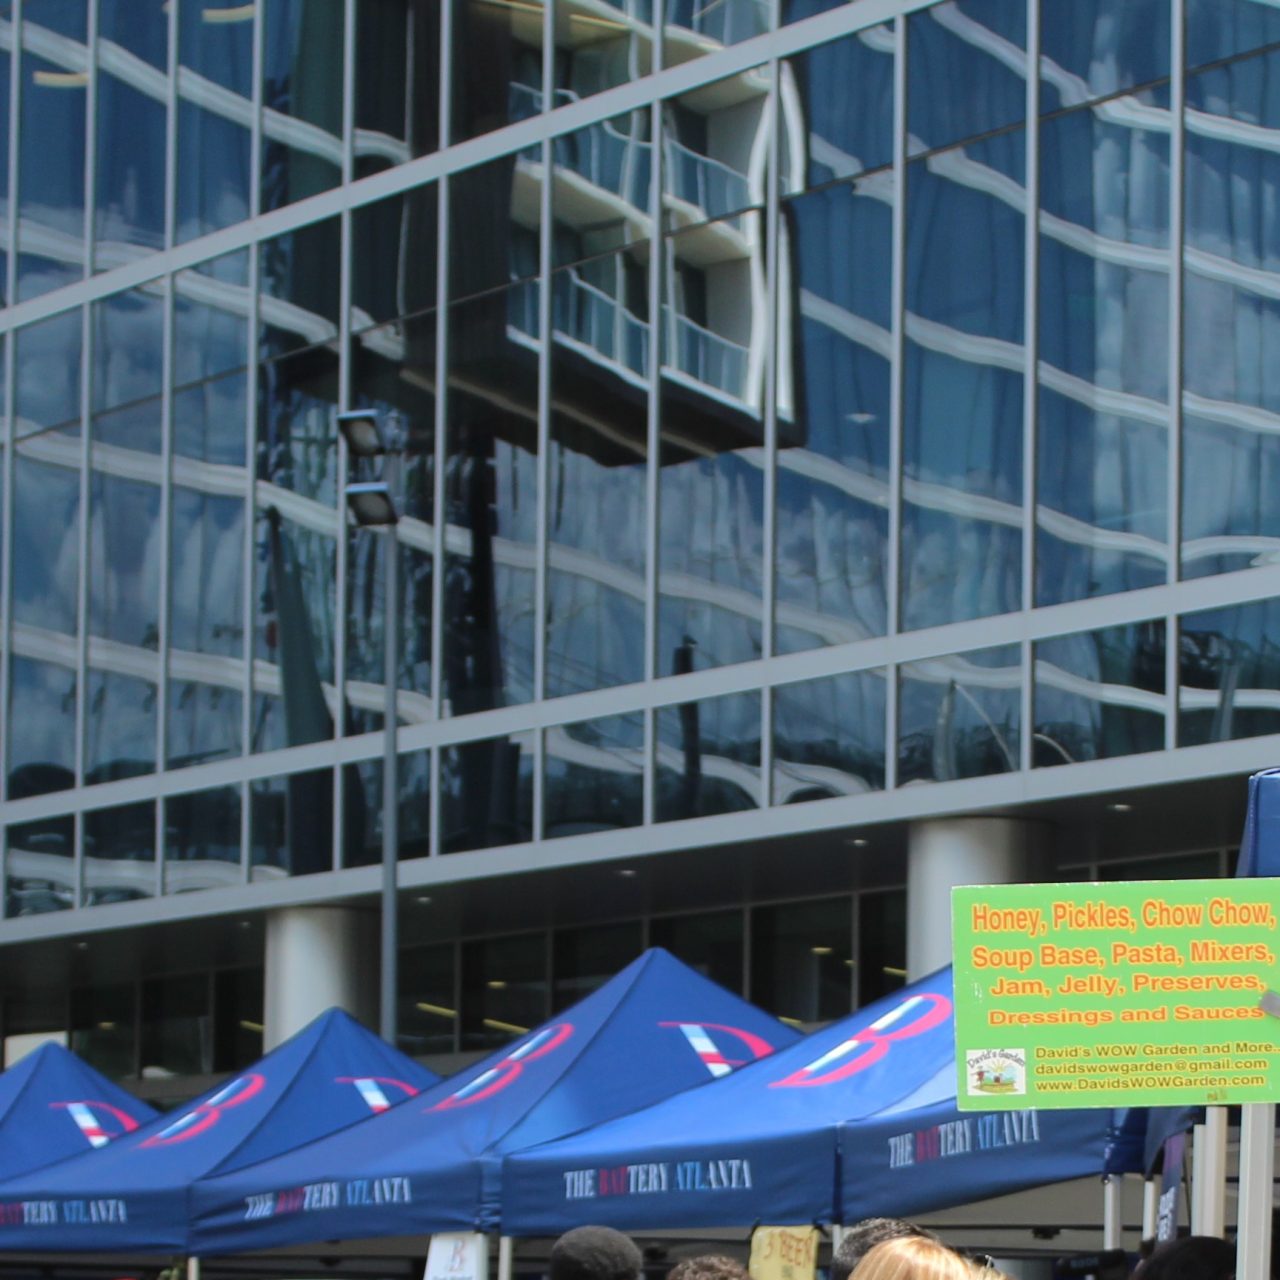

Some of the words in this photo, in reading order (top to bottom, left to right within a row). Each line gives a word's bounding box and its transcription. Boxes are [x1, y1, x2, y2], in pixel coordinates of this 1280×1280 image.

[972, 903, 1048, 937] Honey,
[1053, 900, 1136, 931] Pickles,
[1142, 900, 1202, 928] Chow
[1208, 898, 1276, 929] Chow,
[972, 945, 1033, 972] Soup
[1040, 943, 1105, 968] Base,
[1112, 942, 1183, 966] Pasta,
[1190, 940, 1275, 965] Mixers,
[990, 976, 1051, 997] Jam,
[1058, 974, 1126, 997] Jelly,
[1132, 973, 1266, 992] Preserves,
[988, 1008, 1113, 1027] Dressings
[1120, 1006, 1167, 1022] and
[1174, 1006, 1265, 1021] Sauces
[1035, 1046, 1092, 1059] David's
[1095, 1045, 1138, 1057] WOW
[1142, 1043, 1198, 1056] Garden
[1202, 1042, 1231, 1054] and
[1035, 1060, 1268, 1075] davidswowgarden@gmail.com
[1036, 1075, 1265, 1091] www.DavidsWOWGarden.com
[888, 1132, 914, 1169] THE
[915, 1118, 972, 1163] BATTERY
[564, 1169, 596, 1199] THE
[599, 1162, 670, 1196] BATTERY
[674, 1159, 751, 1191] ATLANTA
[244, 1193, 274, 1220] THE
[346, 1176, 412, 1206] ATLANTA
